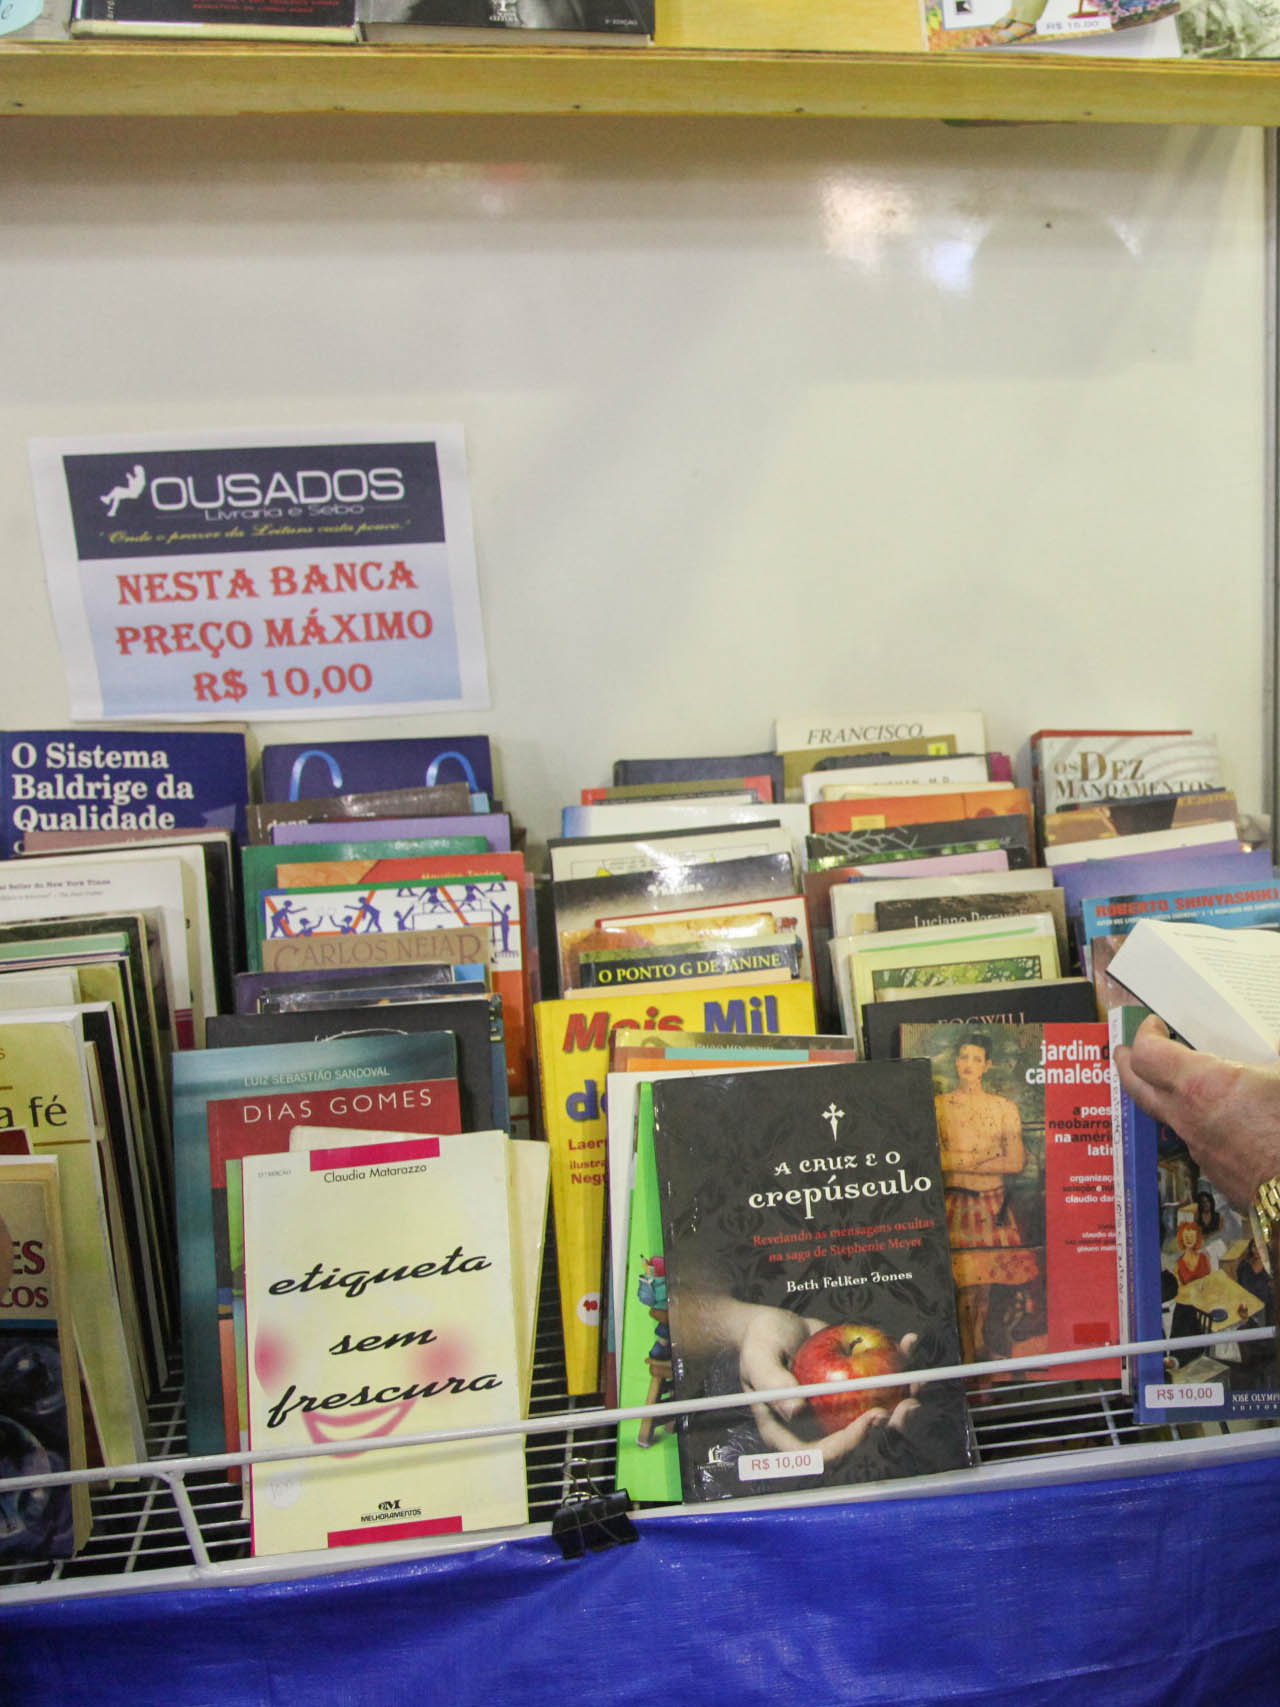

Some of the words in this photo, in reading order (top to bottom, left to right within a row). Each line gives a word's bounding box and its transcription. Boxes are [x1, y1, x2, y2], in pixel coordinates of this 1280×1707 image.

[149, 467, 406, 511] OUSADOS
[204, 507, 284, 522] Livraria
[286, 507, 304, 517] e
[307, 503, 365, 516] Sebo
[225, 525, 246, 539] da
[116, 567, 259, 606] NESTA
[269, 560, 419, 597] BANCA
[114, 619, 253, 659] PREÇO
[264, 608, 434, 649] MÁXIMO
[193, 668, 248, 703] R$
[261, 663, 374, 699] 10,00
[10, 742, 38, 769] O
[45, 742, 170, 769] Sistema
[11, 773, 149, 806] Baldrige
[155, 773, 195, 800] da
[12, 804, 176, 832] Qualidade
[1095, 898, 1169, 918] ROBERTO
[1174, 887, 1280, 911] SHINYASHIKI
[273, 937, 389, 973] CARLOS
[598, 968, 613, 984] O
[616, 963, 677, 982] PONTO
[679, 961, 693, 977] G
[696, 959, 720, 974] DE
[723, 953, 782, 975] JANINE
[703, 995, 779, 1034] Mil
[243, 1074, 269, 1087] LUIZ
[271, 1069, 332, 1085] SEBASTIÃO
[334, 1066, 390, 1081] SANDOVAL
[28, 1094, 68, 1128] fé
[243, 1100, 312, 1124] DIAS
[329, 1088, 432, 1115] GOMES
[323, 1168, 366, 1184] Claudia
[369, 1164, 428, 1179] Matarazzo
[773, 1161, 792, 1176] A
[799, 1153, 858, 1173] CRUZ
[885, 1150, 902, 1165] O
[747, 1169, 933, 1220] crepúsculo
[1064, 1193, 1098, 1204] claudio
[753, 1229, 813, 1247] Revelando
[815, 1230, 828, 1241] as
[829, 1224, 892, 1239] mensagens
[893, 1215, 937, 1231] ocultas
[768, 1252, 783, 1263] na
[785, 1250, 811, 1263] saga
[813, 1245, 828, 1257] de
[887, 1235, 924, 1251] Meyer
[268, 1246, 493, 1299] etiqueta
[786, 1278, 819, 1293] Beth
[822, 1274, 868, 1289] Felker
[870, 1270, 914, 1284] Jones
[329, 1329, 438, 1356] sem
[266, 1373, 503, 1429] frescura
[1156, 1388, 1175, 1401] R$
[1178, 1387, 1213, 1401] 10,00
[751, 1458, 771, 1472] R$
[774, 1454, 812, 1470] 10,00
[360, 1508, 422, 1523] MELHORAMENTOS
